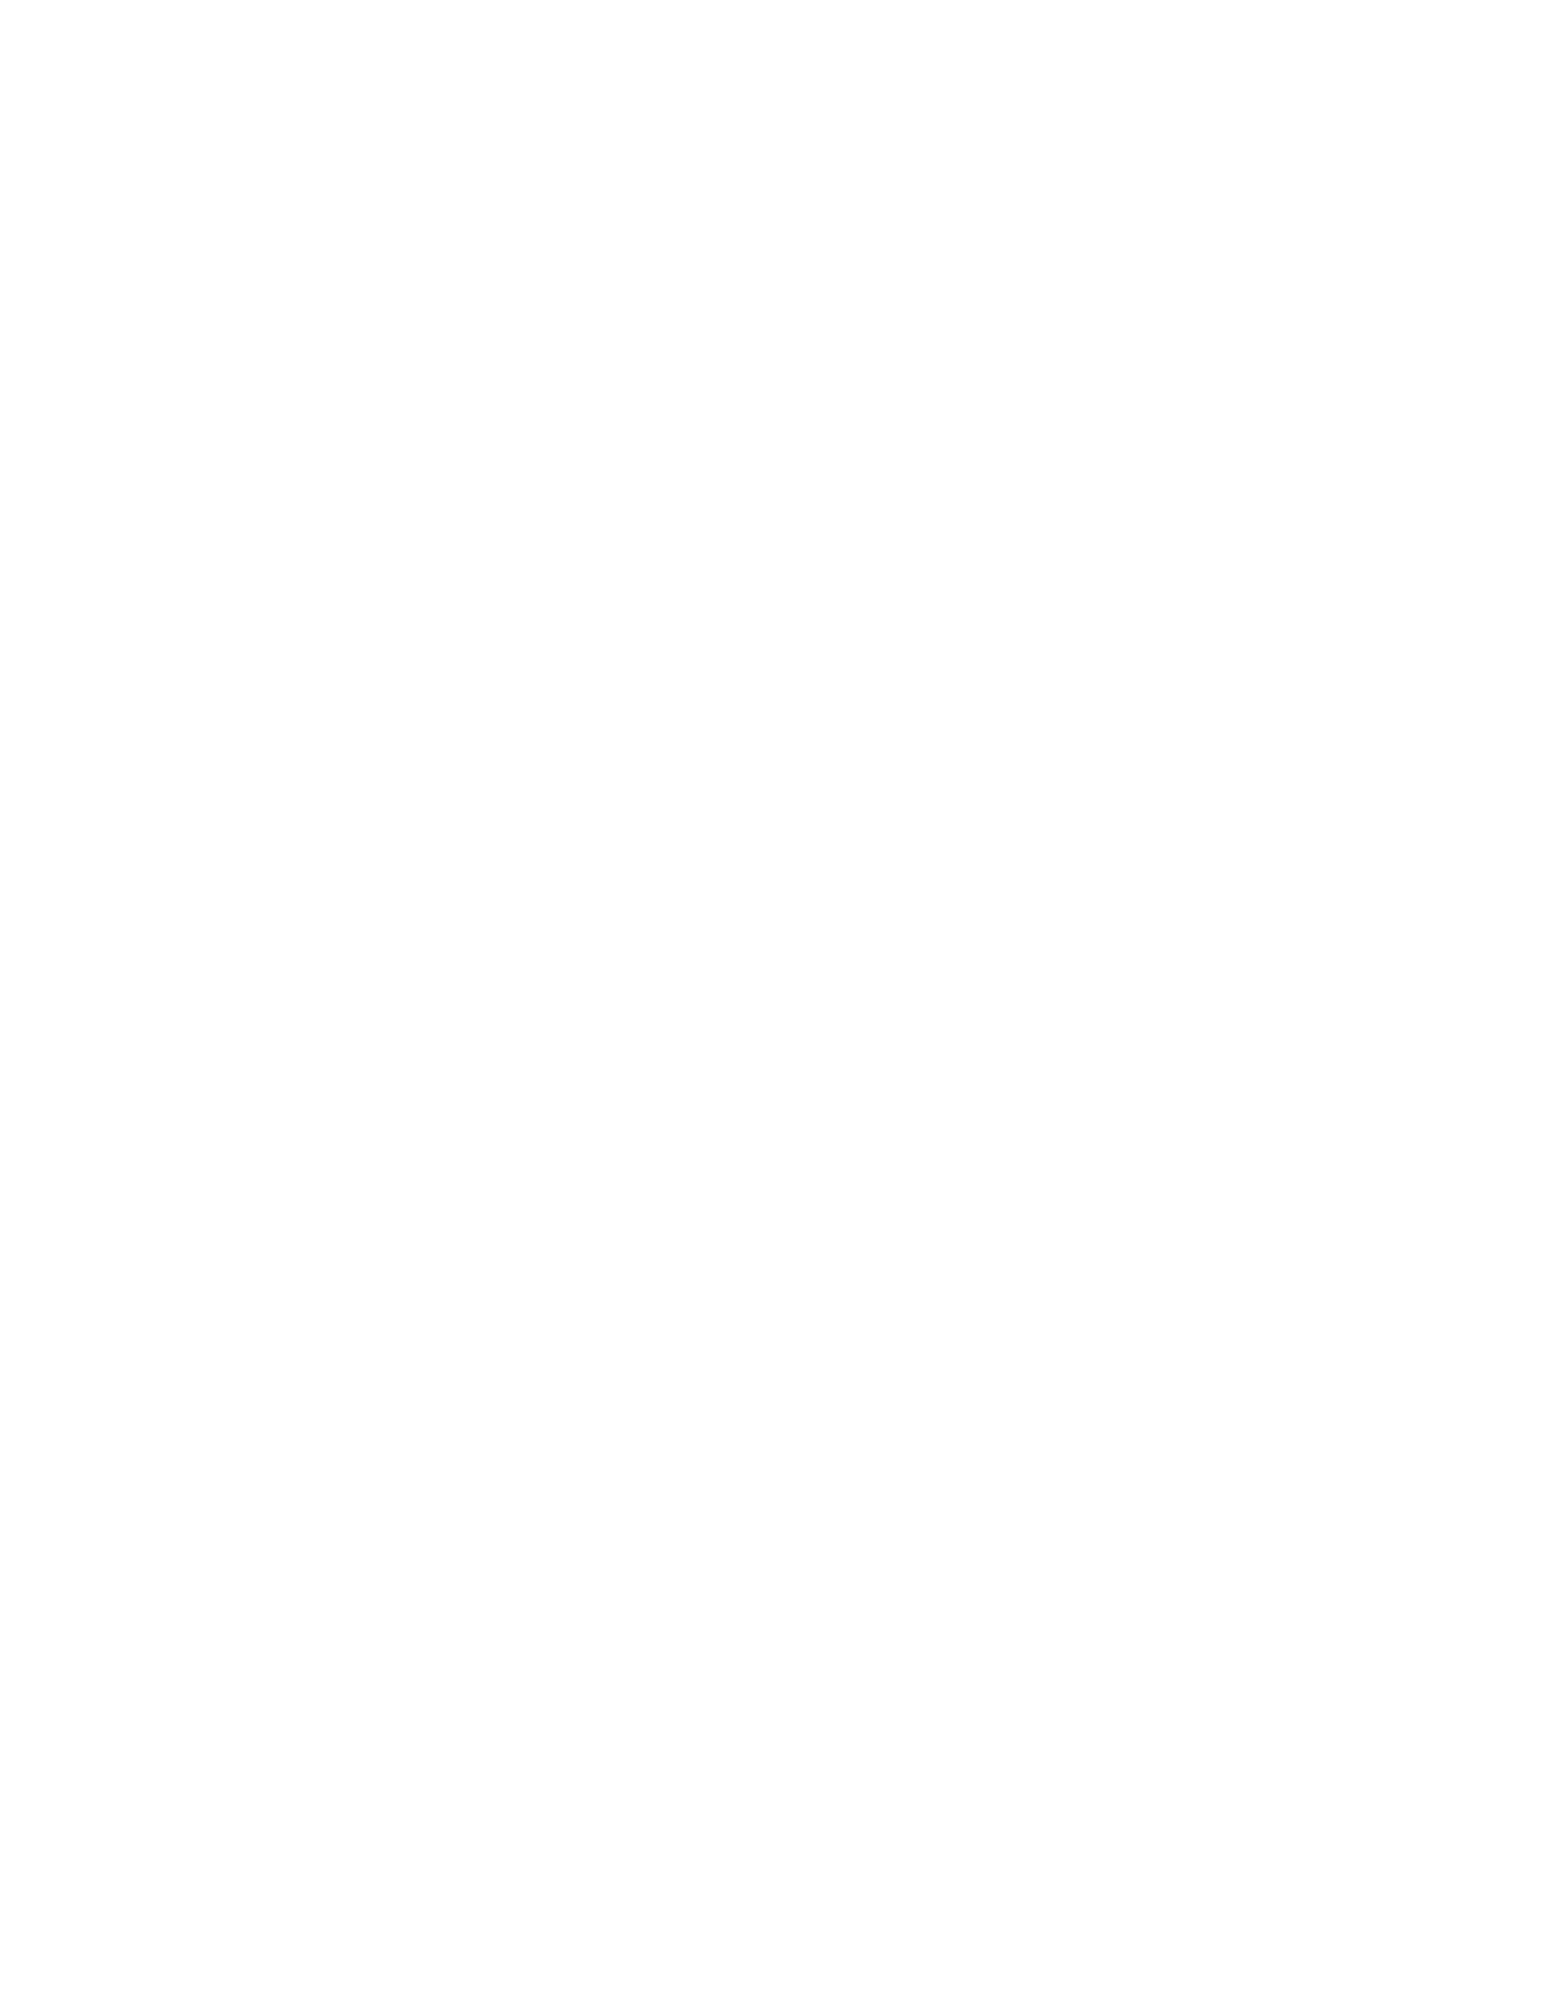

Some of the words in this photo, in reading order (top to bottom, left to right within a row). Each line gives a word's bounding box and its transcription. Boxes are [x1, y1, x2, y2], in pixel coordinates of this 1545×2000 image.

[384, 712, 1160, 832] OAKLAND
[448, 872, 1096, 936] ARENA
[232, 1272, 1296, 1368] COLISEUM
